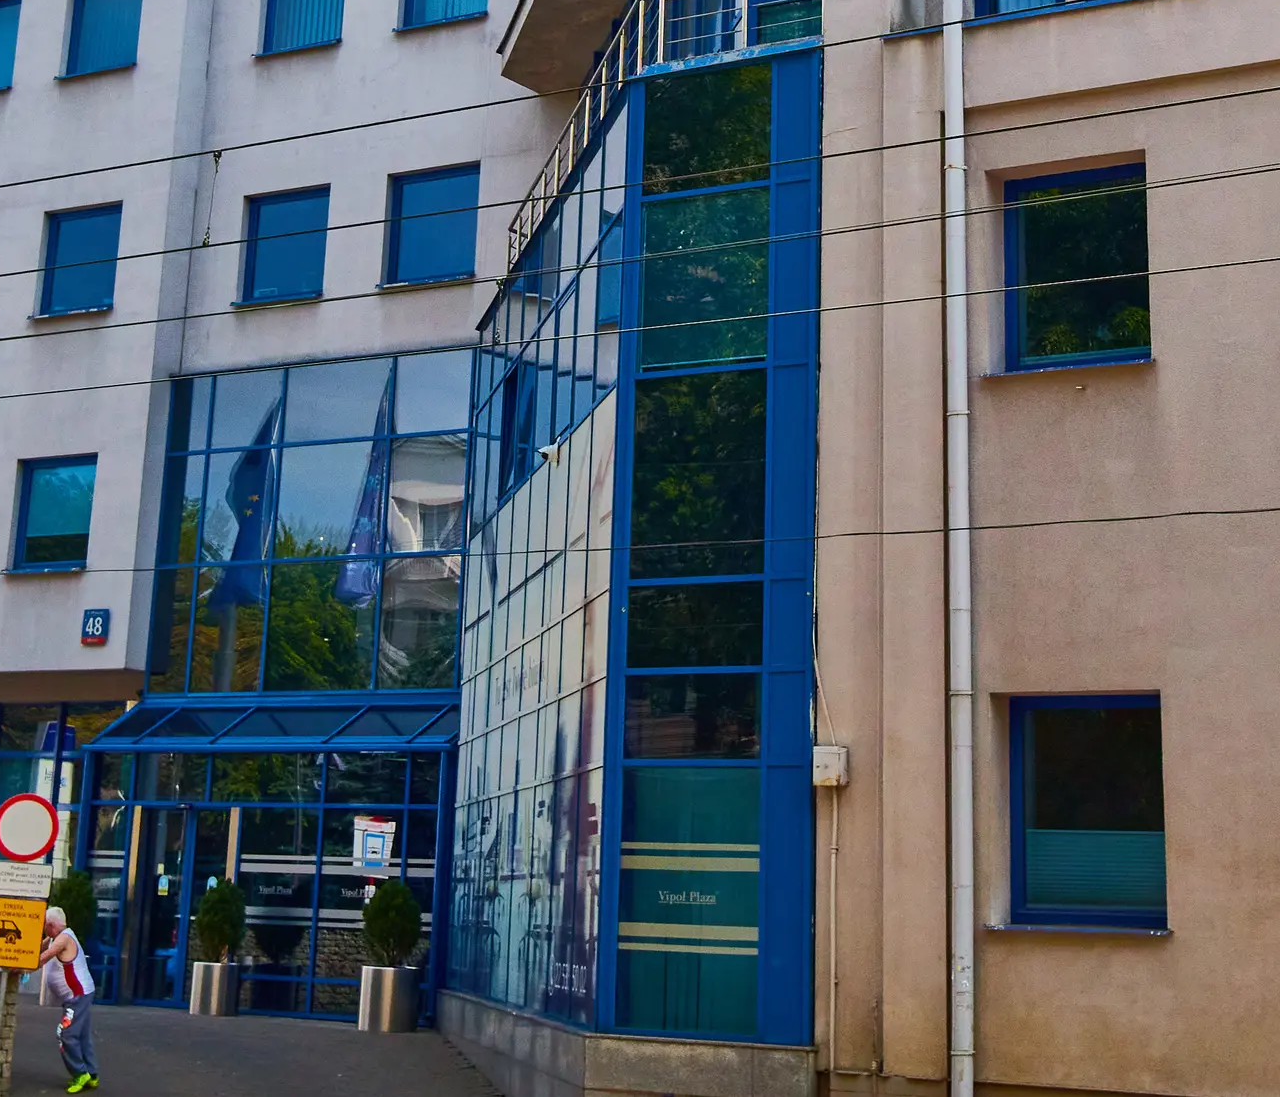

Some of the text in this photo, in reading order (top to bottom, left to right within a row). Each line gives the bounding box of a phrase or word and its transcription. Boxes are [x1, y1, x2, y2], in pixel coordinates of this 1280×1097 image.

[85, 617, 103, 636] 48
[658, 890, 716, 905] Vipol Plaza
